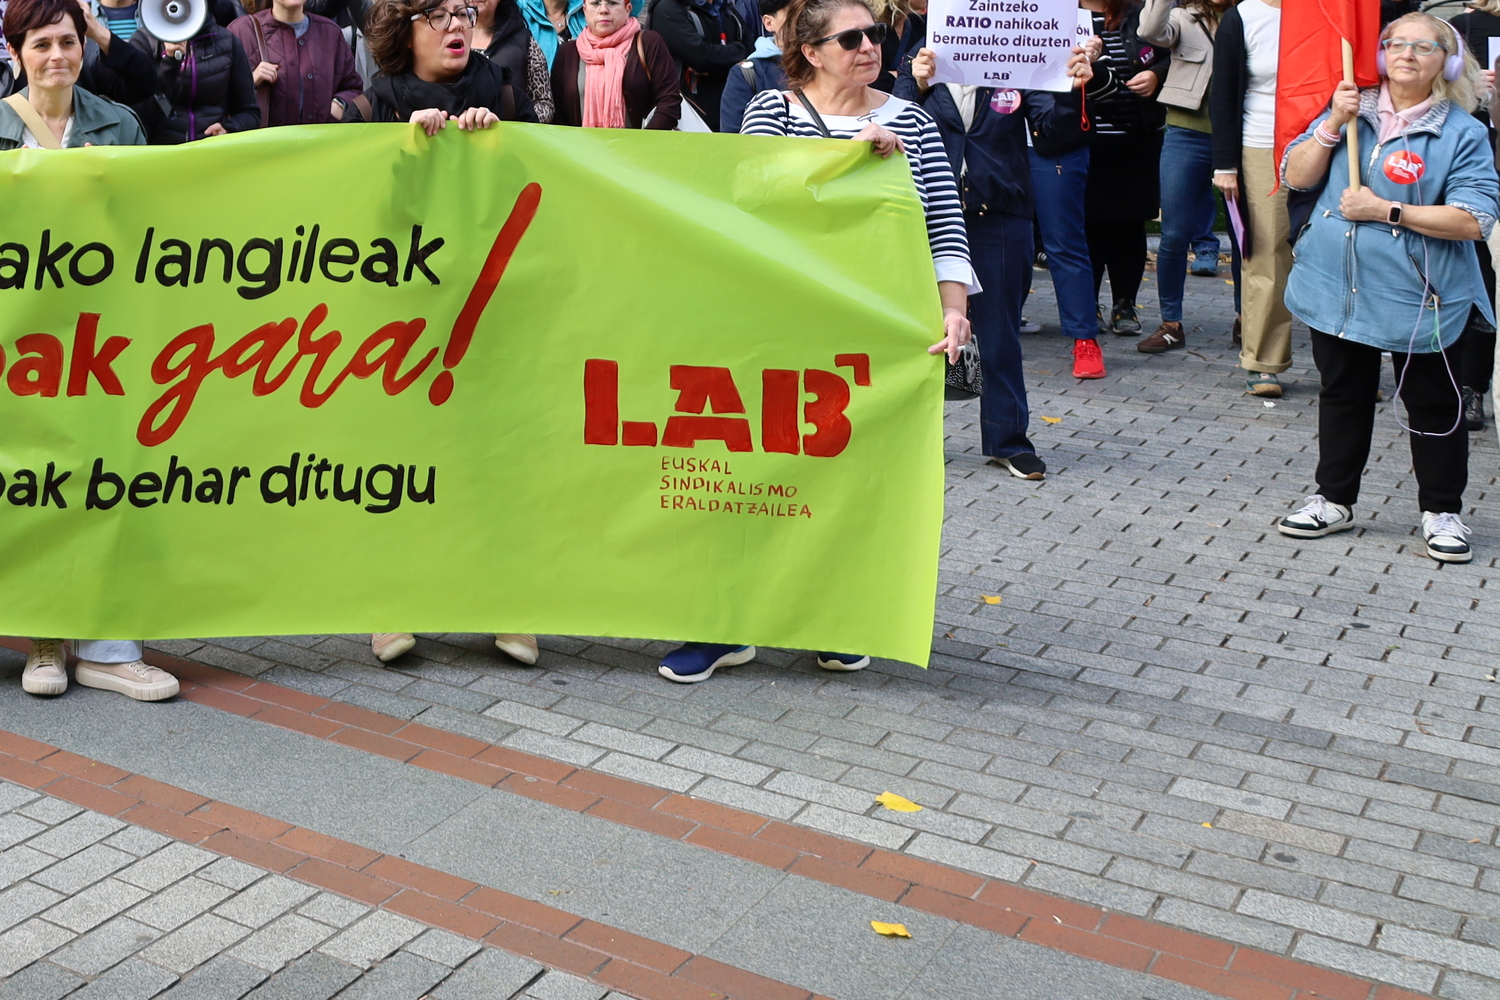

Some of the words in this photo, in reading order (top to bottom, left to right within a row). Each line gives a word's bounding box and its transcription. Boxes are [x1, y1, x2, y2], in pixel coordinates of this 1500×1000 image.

[969, 0, 1039, 12] Zaintzeko
[946, 15, 992, 28] RATIO
[995, 18, 1059, 30] nahikoak
[933, 31, 1009, 46] bermatuko
[1012, 34, 1071, 47] dituzten
[953, 52, 1047, 64] aurrekontuak
[984, 71, 1012, 80] LAB
[134, 222, 446, 300] langileak
[584, 353, 871, 458] LAB
[661, 456, 732, 475] EUSKAL
[86, 454, 254, 510] behar
[258, 451, 437, 515] ditugu
[659, 474, 798, 499] SINDIKALISMO
[660, 494, 813, 519] ERALDATZAILEA
